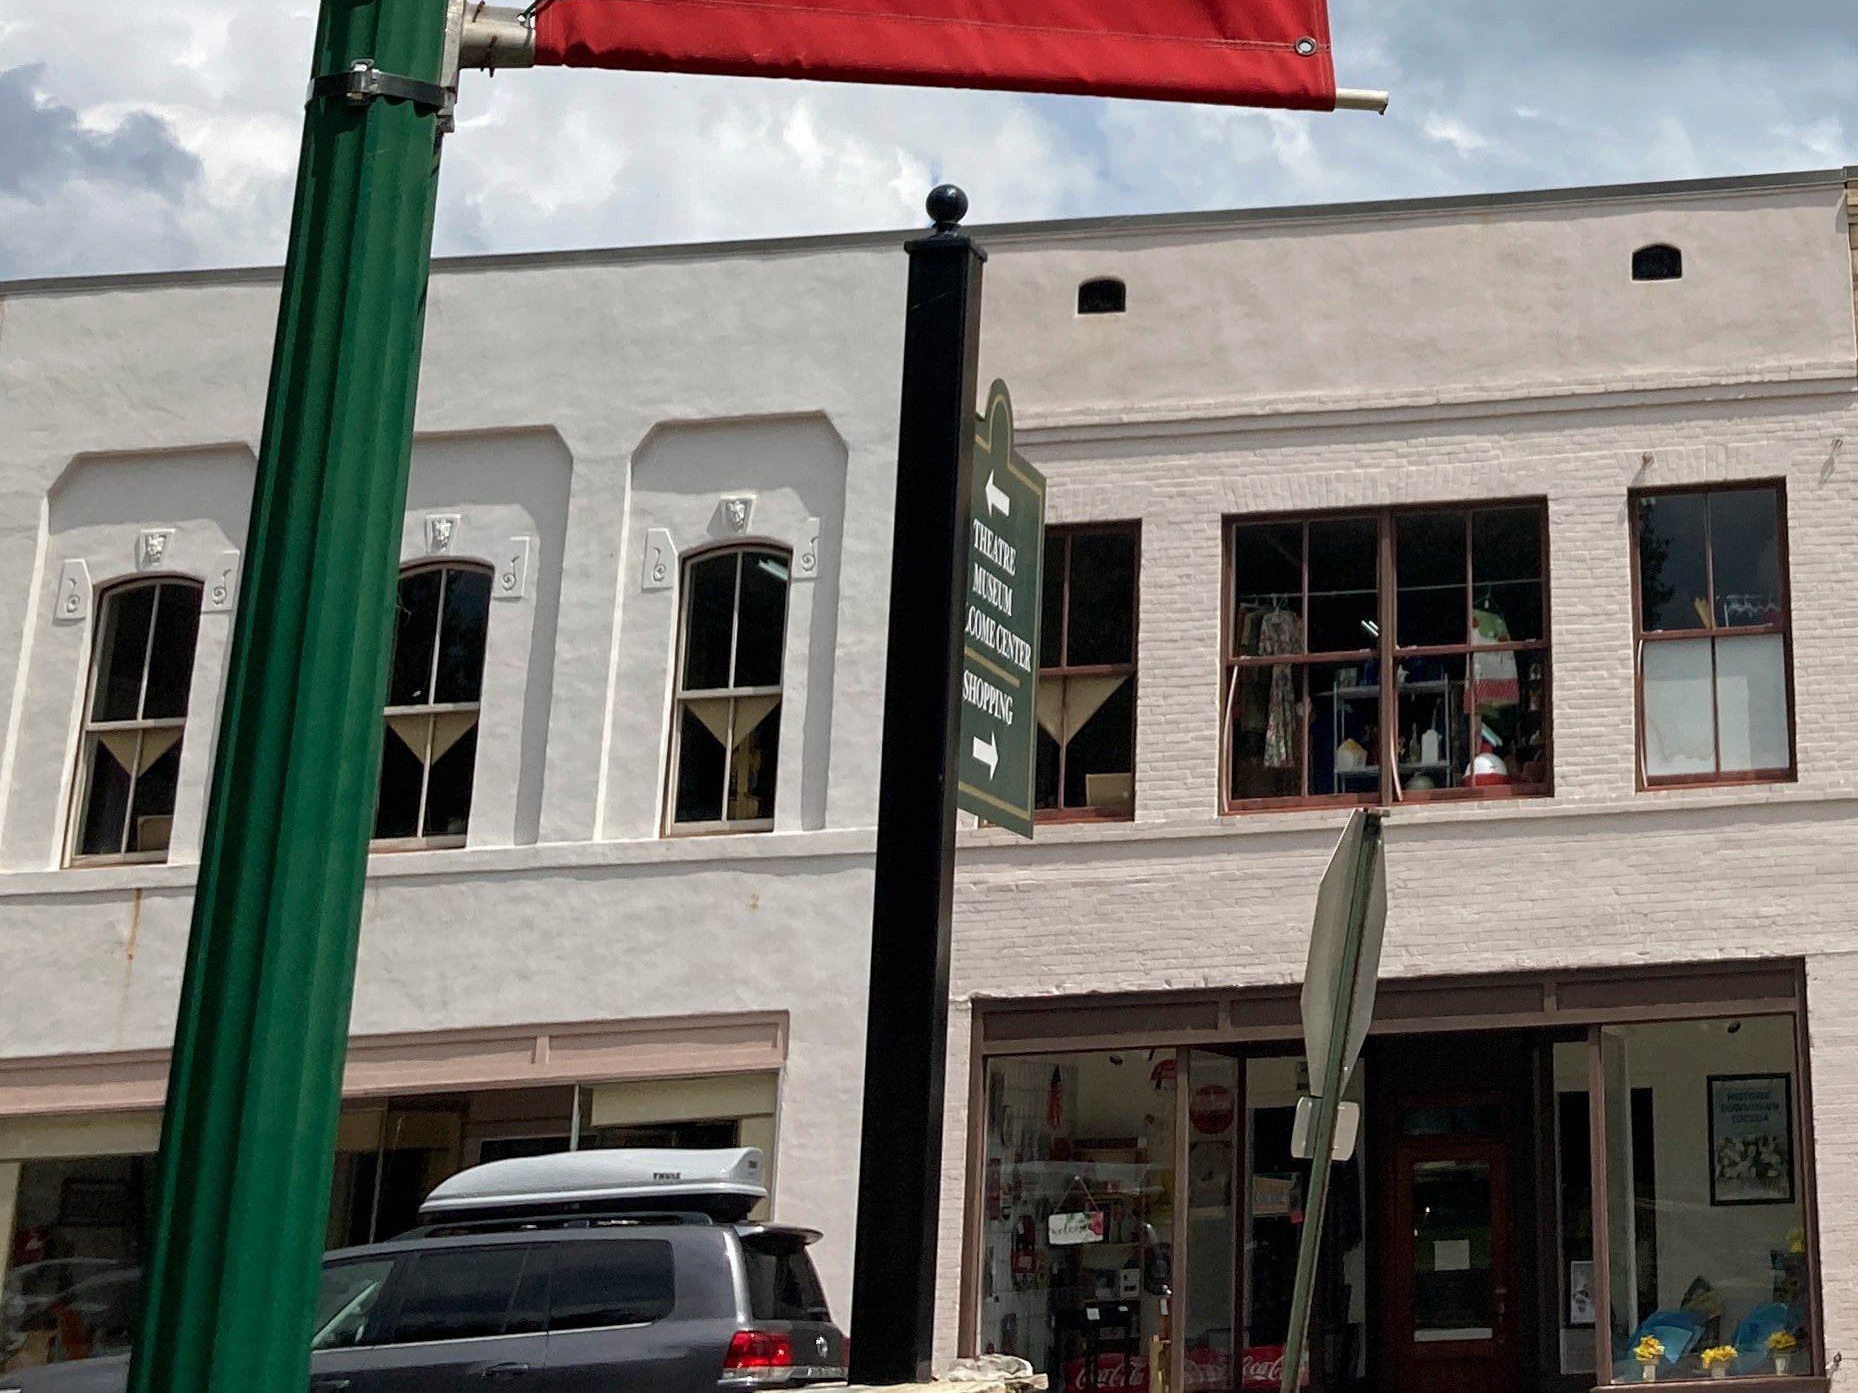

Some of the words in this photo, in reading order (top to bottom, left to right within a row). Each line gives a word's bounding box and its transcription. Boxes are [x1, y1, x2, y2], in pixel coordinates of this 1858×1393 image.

[973, 518, 1017, 576] THEATRE
[972, 562, 1013, 616] MUSEUM
[965, 605, 995, 648] COME
[996, 624, 1031, 672] CENTER
[962, 670, 1013, 725] SHOPPING
